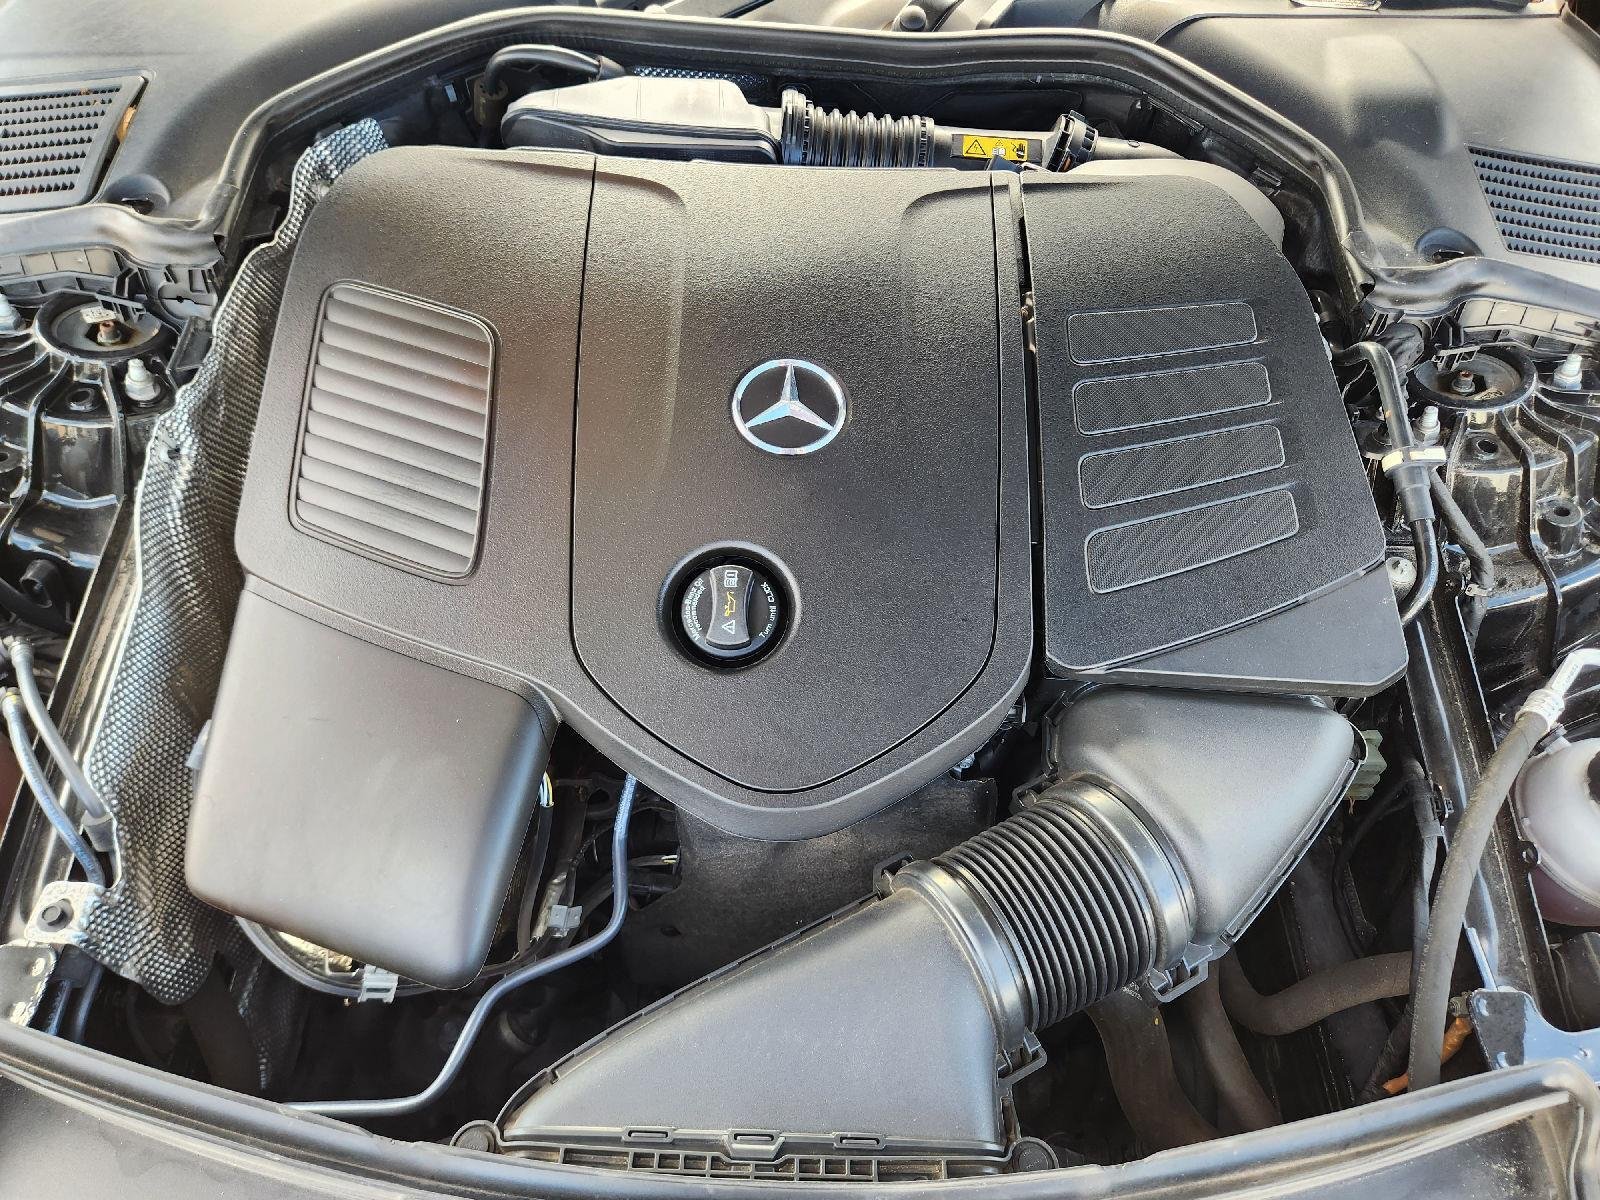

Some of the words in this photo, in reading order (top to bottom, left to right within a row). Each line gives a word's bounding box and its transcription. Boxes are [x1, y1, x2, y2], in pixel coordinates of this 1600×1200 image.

[760, 581, 775, 603] CLICK
[769, 605, 777, 622] until
[758, 623, 773, 638] Turn
